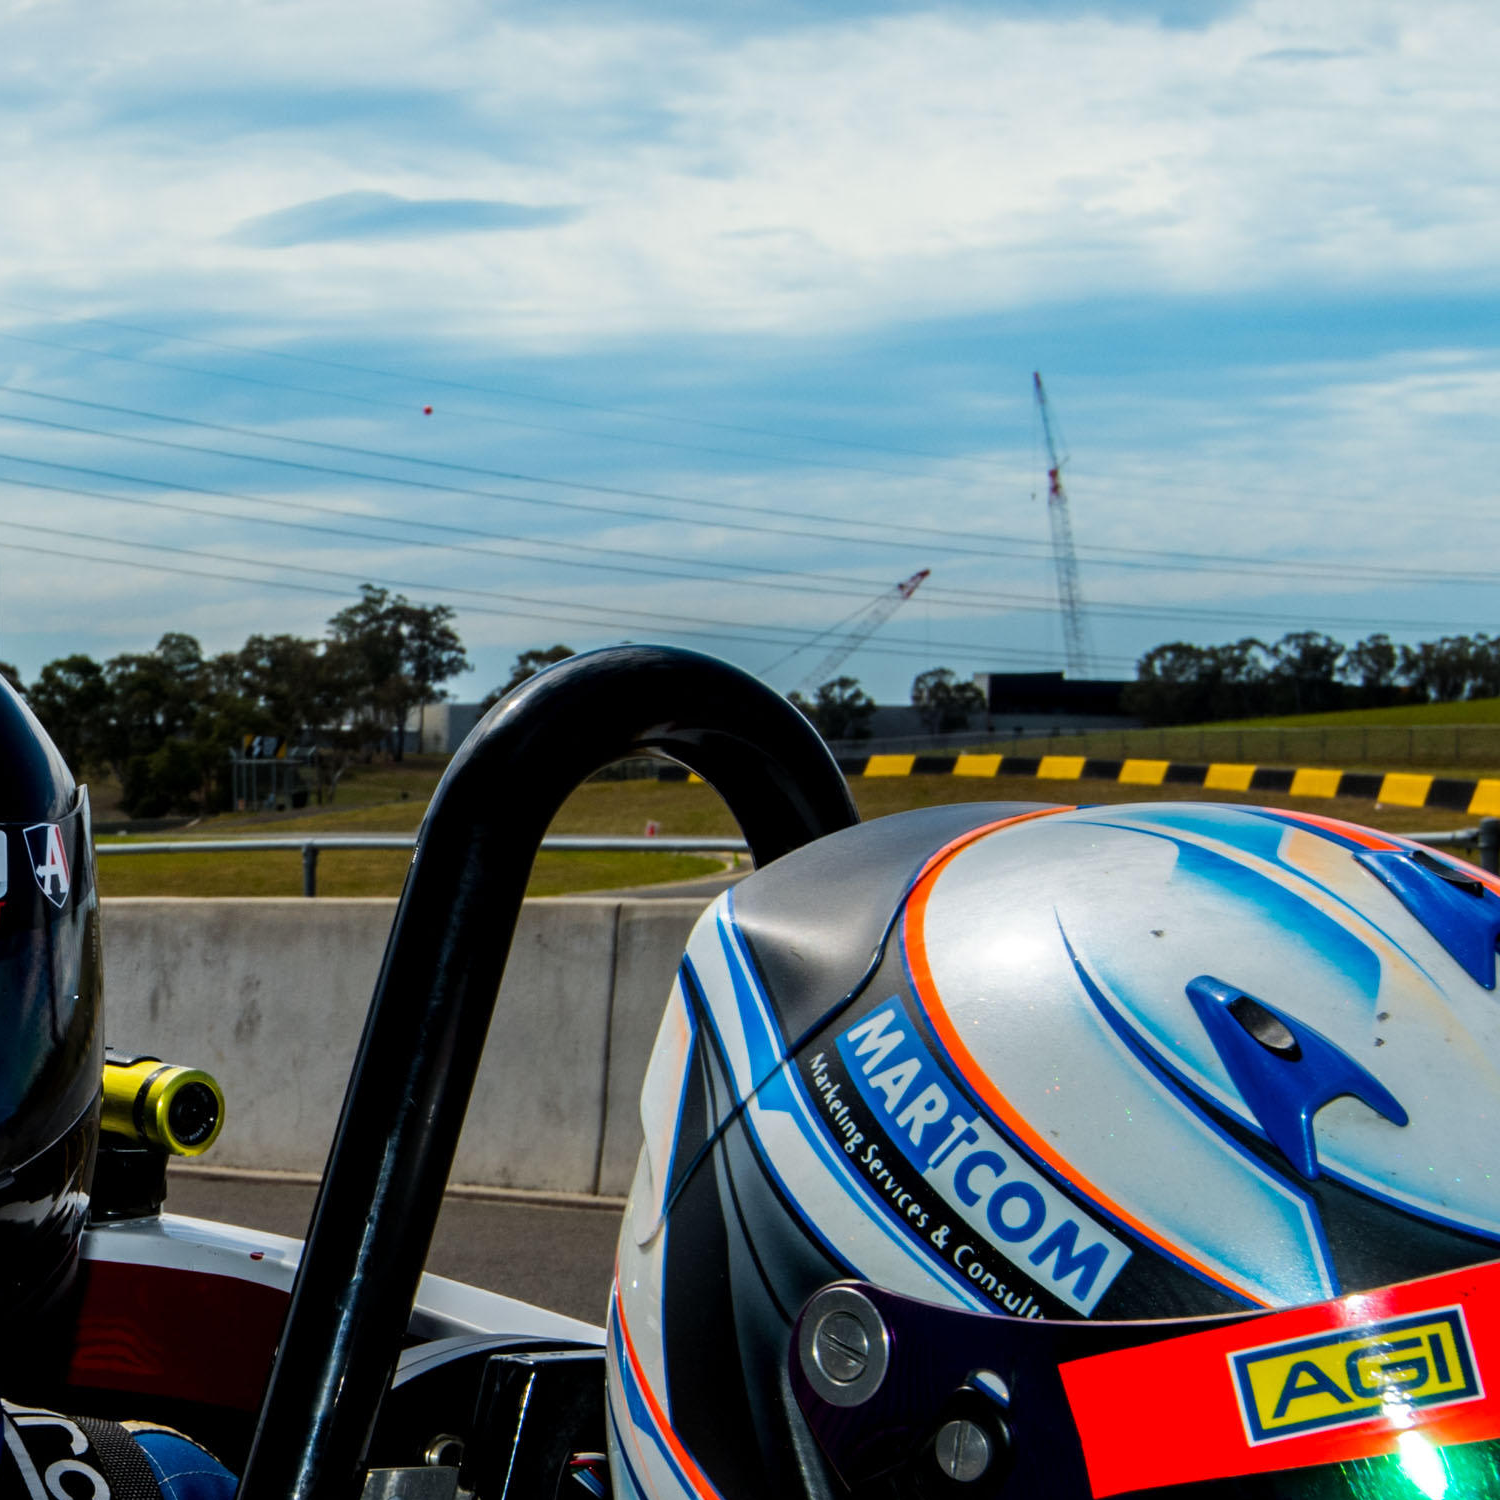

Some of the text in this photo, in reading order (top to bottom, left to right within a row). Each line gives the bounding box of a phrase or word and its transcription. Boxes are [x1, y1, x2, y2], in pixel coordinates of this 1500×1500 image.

[809, 1052, 1045, 1320] Marketing Services & Consult
[847, 1009, 1110, 1302] MARTCOM
[1272, 1332, 1452, 1420] AGI
